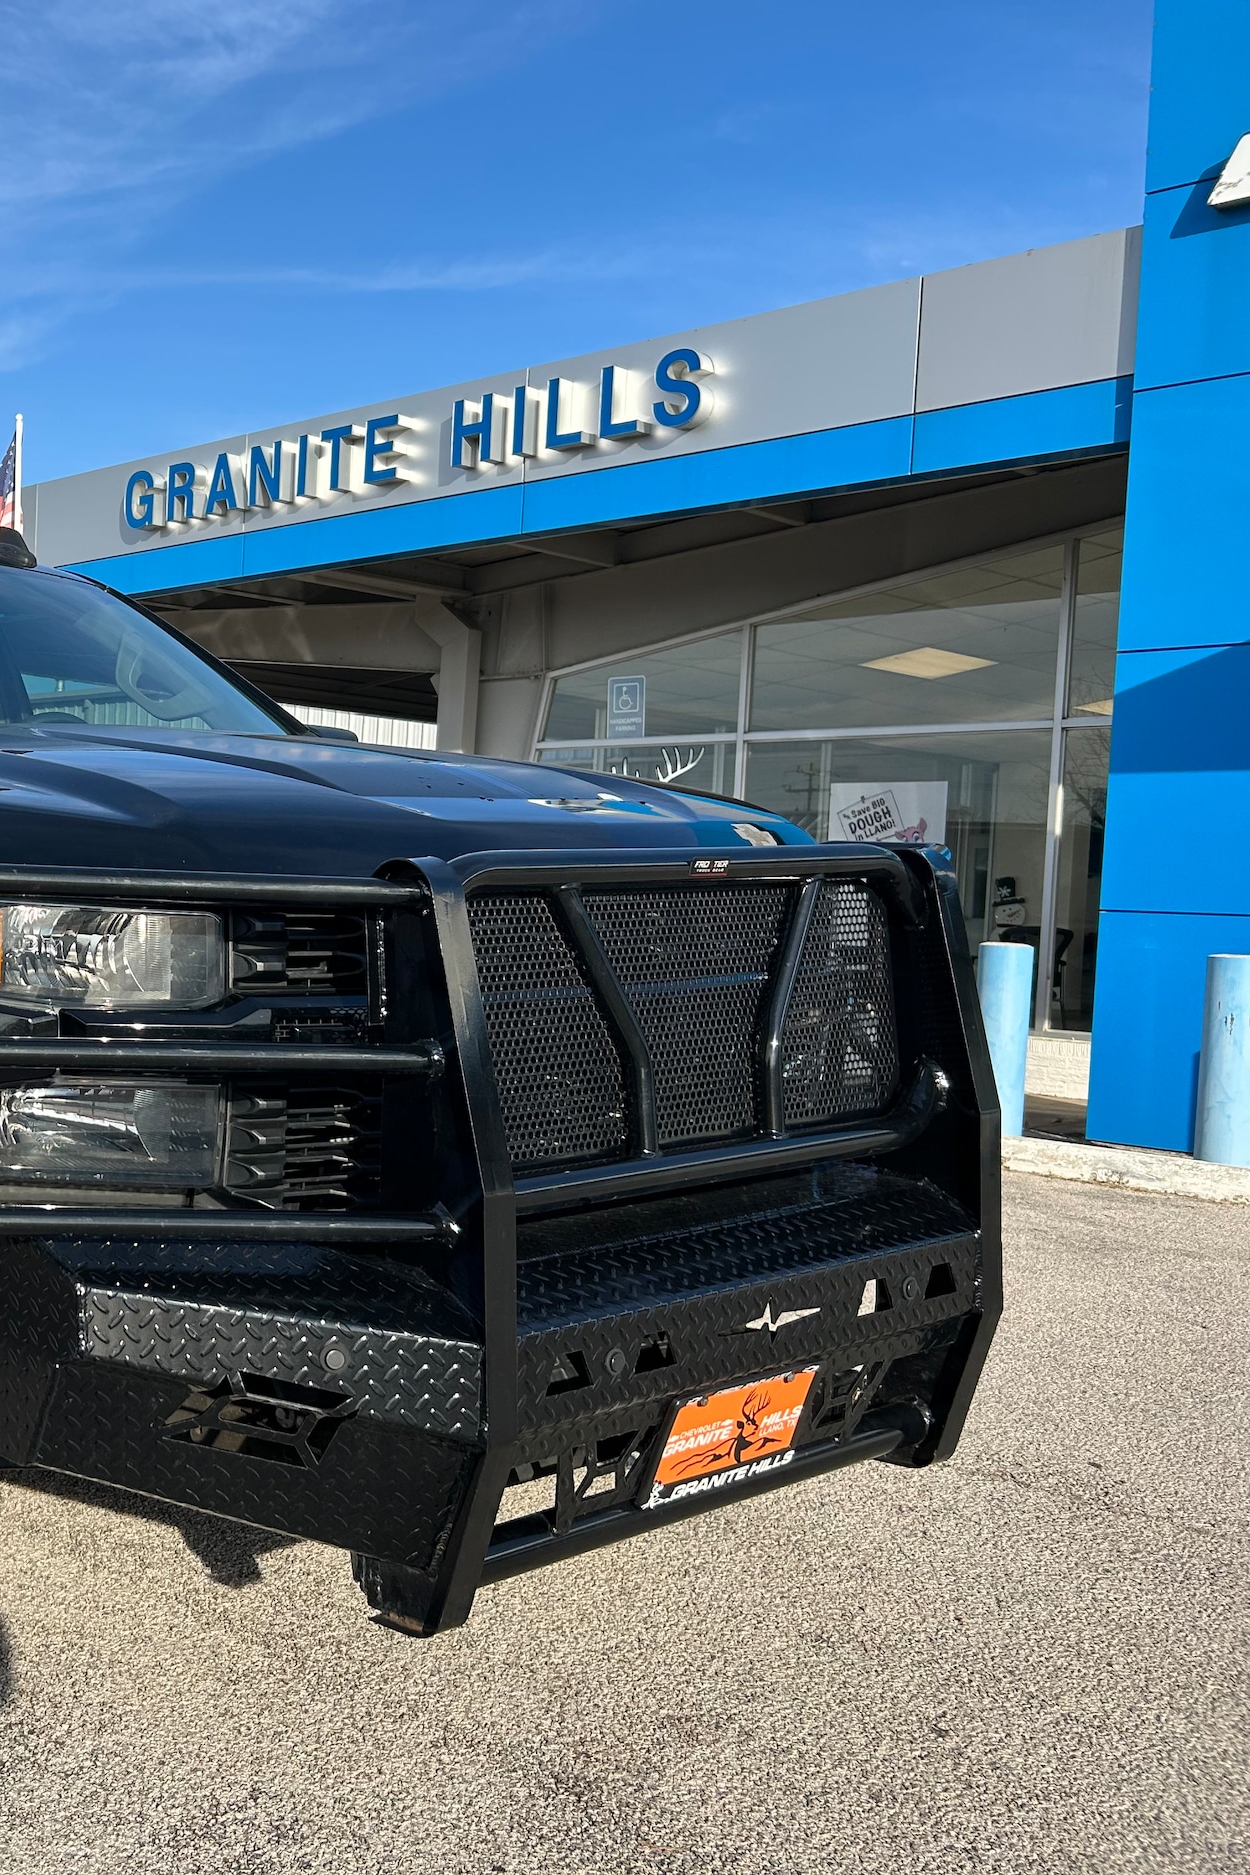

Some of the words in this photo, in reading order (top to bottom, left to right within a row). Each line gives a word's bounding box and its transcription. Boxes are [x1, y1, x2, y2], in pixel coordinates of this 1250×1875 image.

[124, 413, 405, 531] GRANITE
[452, 348, 707, 472] HILLS
[848, 806, 892, 835] DOUGH
[679, 1421, 721, 1439] CHEVROLET
[760, 1404, 803, 1428] HILLS
[662, 1425, 733, 1458] GRANITE
[670, 1465, 750, 1499] GRANITE
[748, 1450, 796, 1477] HILLS
